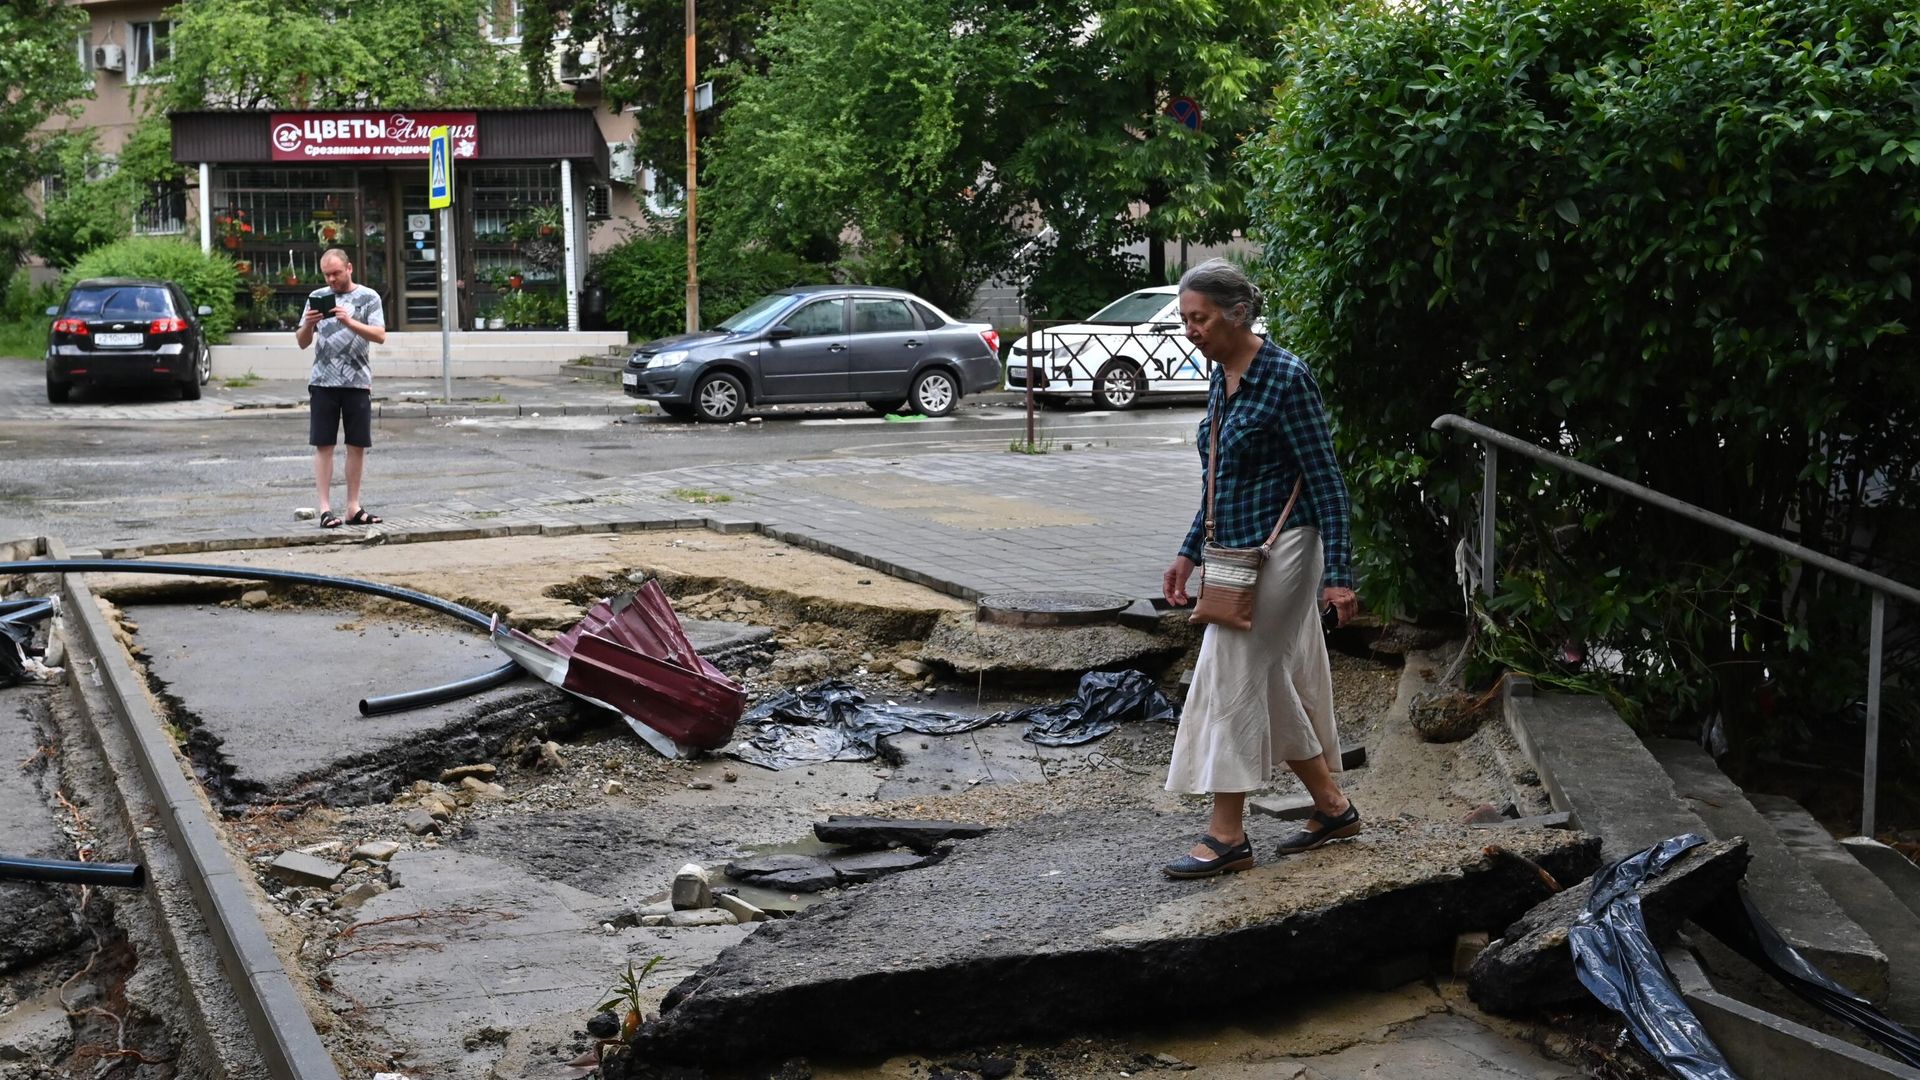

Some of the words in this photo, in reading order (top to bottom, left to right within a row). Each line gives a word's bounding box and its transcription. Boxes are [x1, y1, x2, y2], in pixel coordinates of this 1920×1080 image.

[304, 119, 386, 143] ЦВЕТЫ
[386, 113, 475, 143] Амия
[279, 130, 298, 142] 24
[304, 144, 371, 157] Срезанные
[372, 145, 381, 155] и
